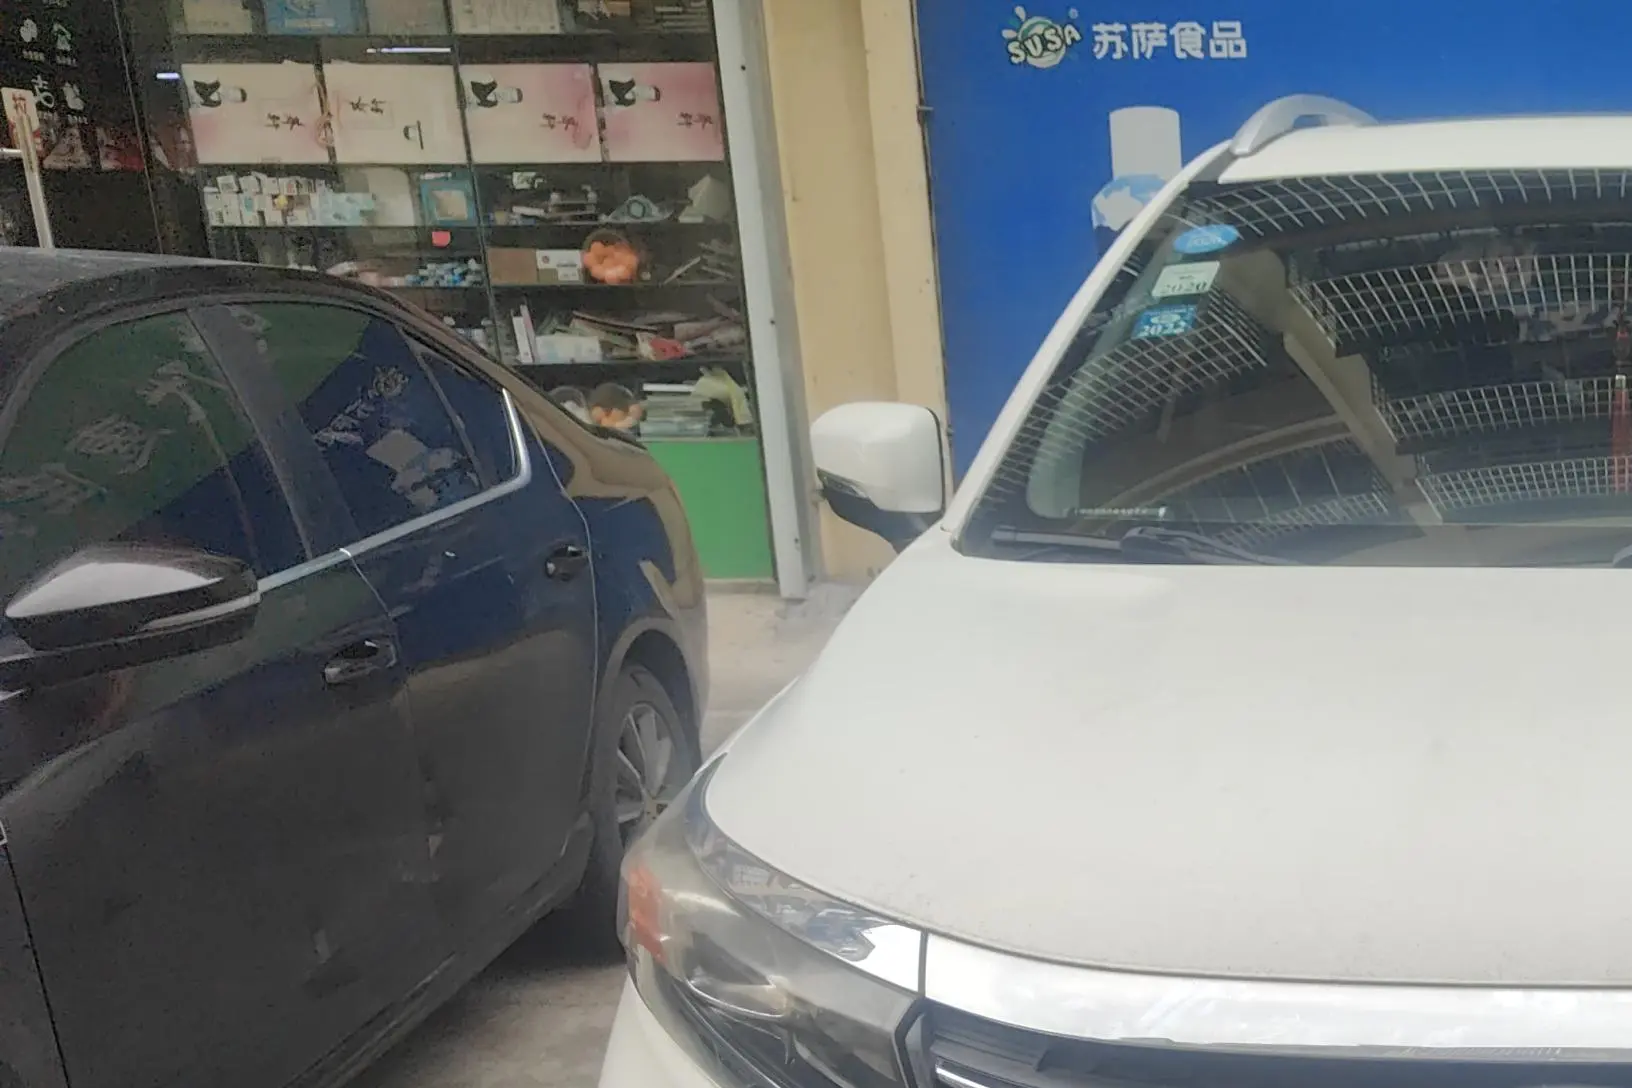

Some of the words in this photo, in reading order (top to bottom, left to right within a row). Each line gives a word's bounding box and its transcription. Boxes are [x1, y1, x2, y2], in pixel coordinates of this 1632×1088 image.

[1006, 22, 1082, 65] SUSA
[1091, 20, 1247, 60] 苏萨食品
